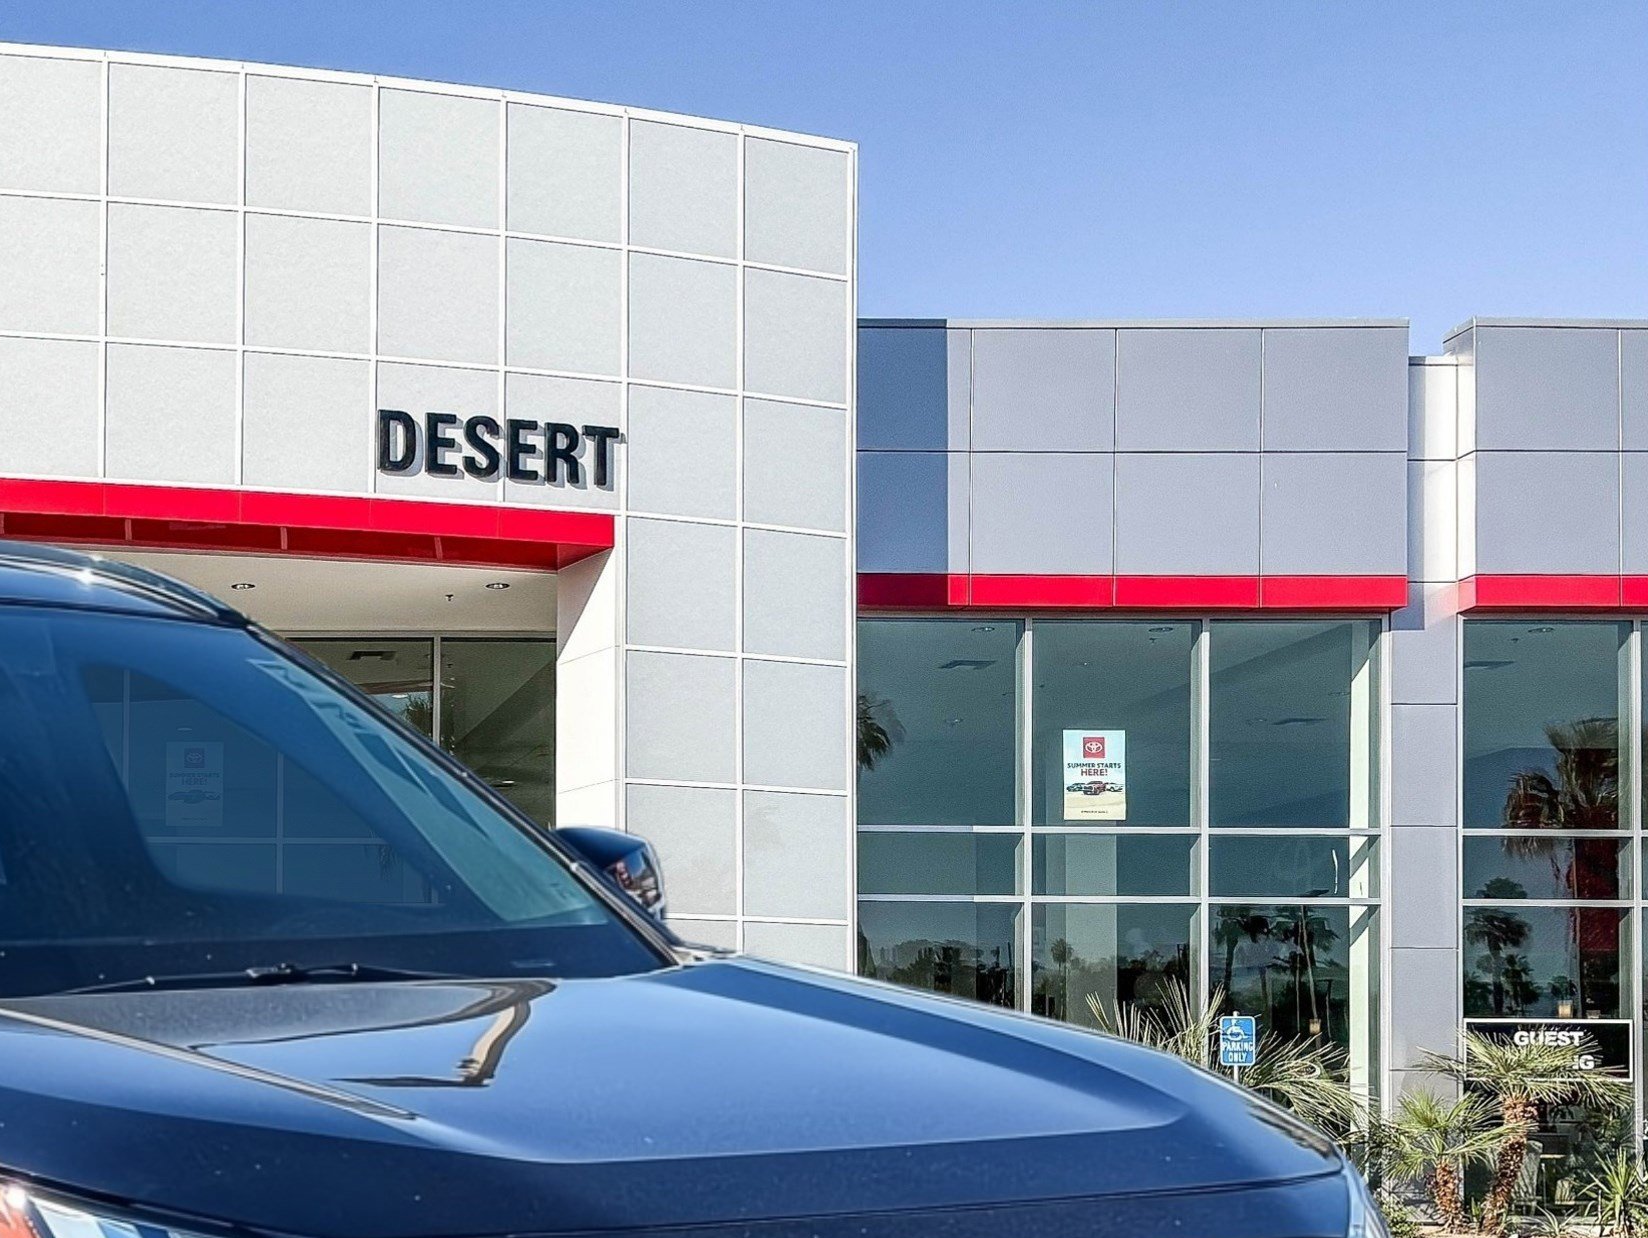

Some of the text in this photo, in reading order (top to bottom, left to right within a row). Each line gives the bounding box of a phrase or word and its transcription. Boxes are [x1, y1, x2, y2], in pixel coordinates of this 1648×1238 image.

[377, 409, 621, 487] DESERT
[1080, 768, 1108, 777] HERE!
[1513, 1030, 1584, 1047] GUEST
[1222, 1041, 1253, 1052] PARKING
[1228, 1051, 1247, 1063] ONLY
